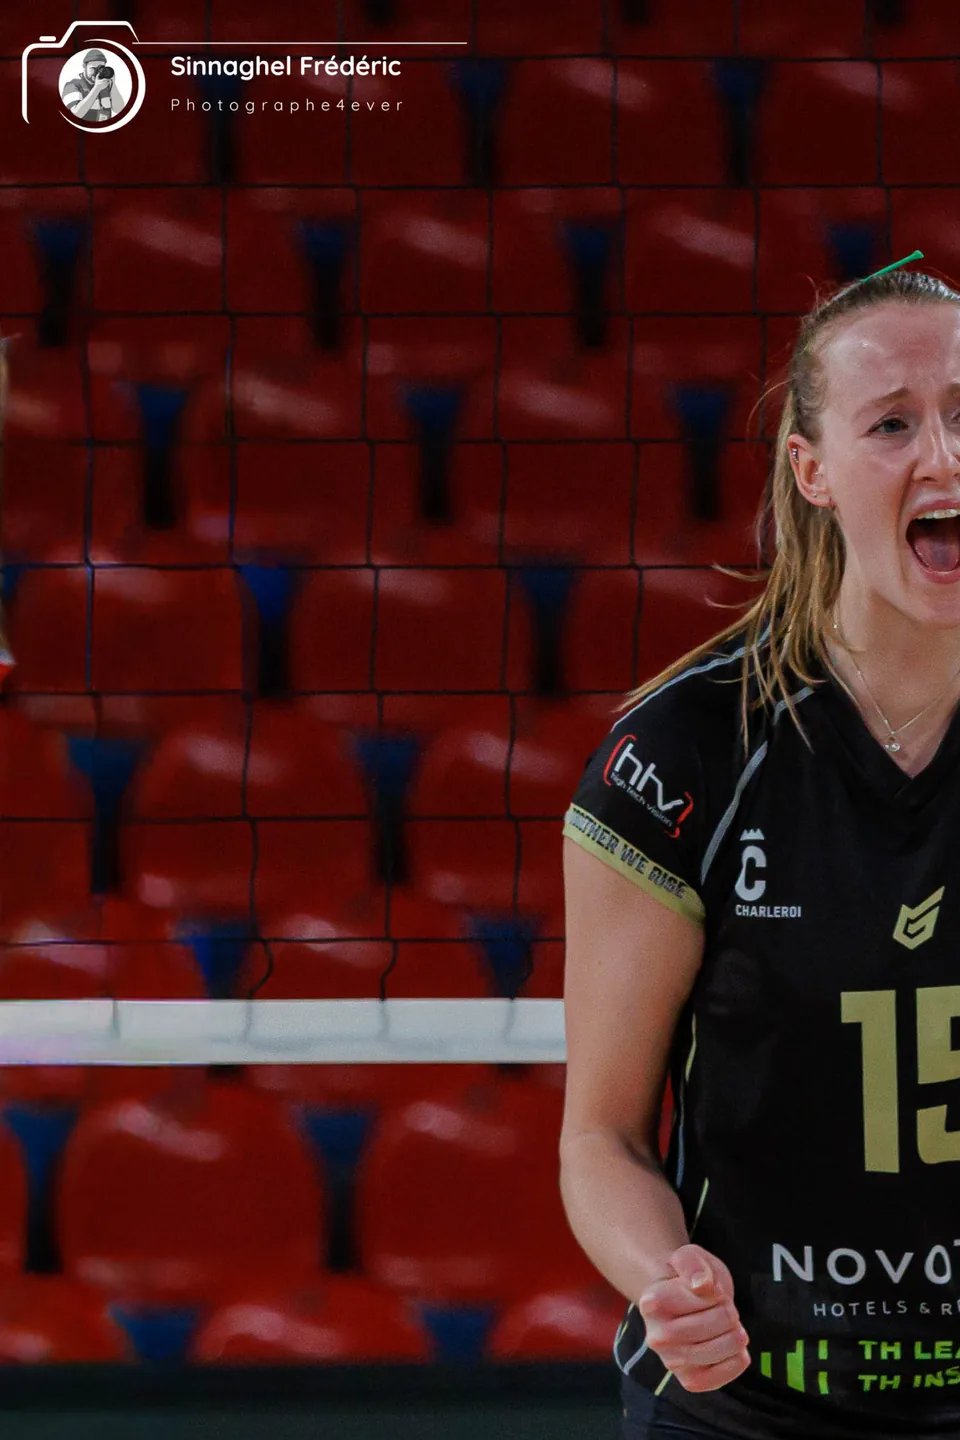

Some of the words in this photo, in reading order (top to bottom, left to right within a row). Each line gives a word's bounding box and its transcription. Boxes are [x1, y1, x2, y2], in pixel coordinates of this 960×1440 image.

[735, 904, 802, 918] CHARLEROI
[813, 1300, 908, 1317] HOTELS
[919, 1302, 931, 1315] &
[858, 1340, 902, 1360] TH
[858, 1375, 902, 1392] TH
